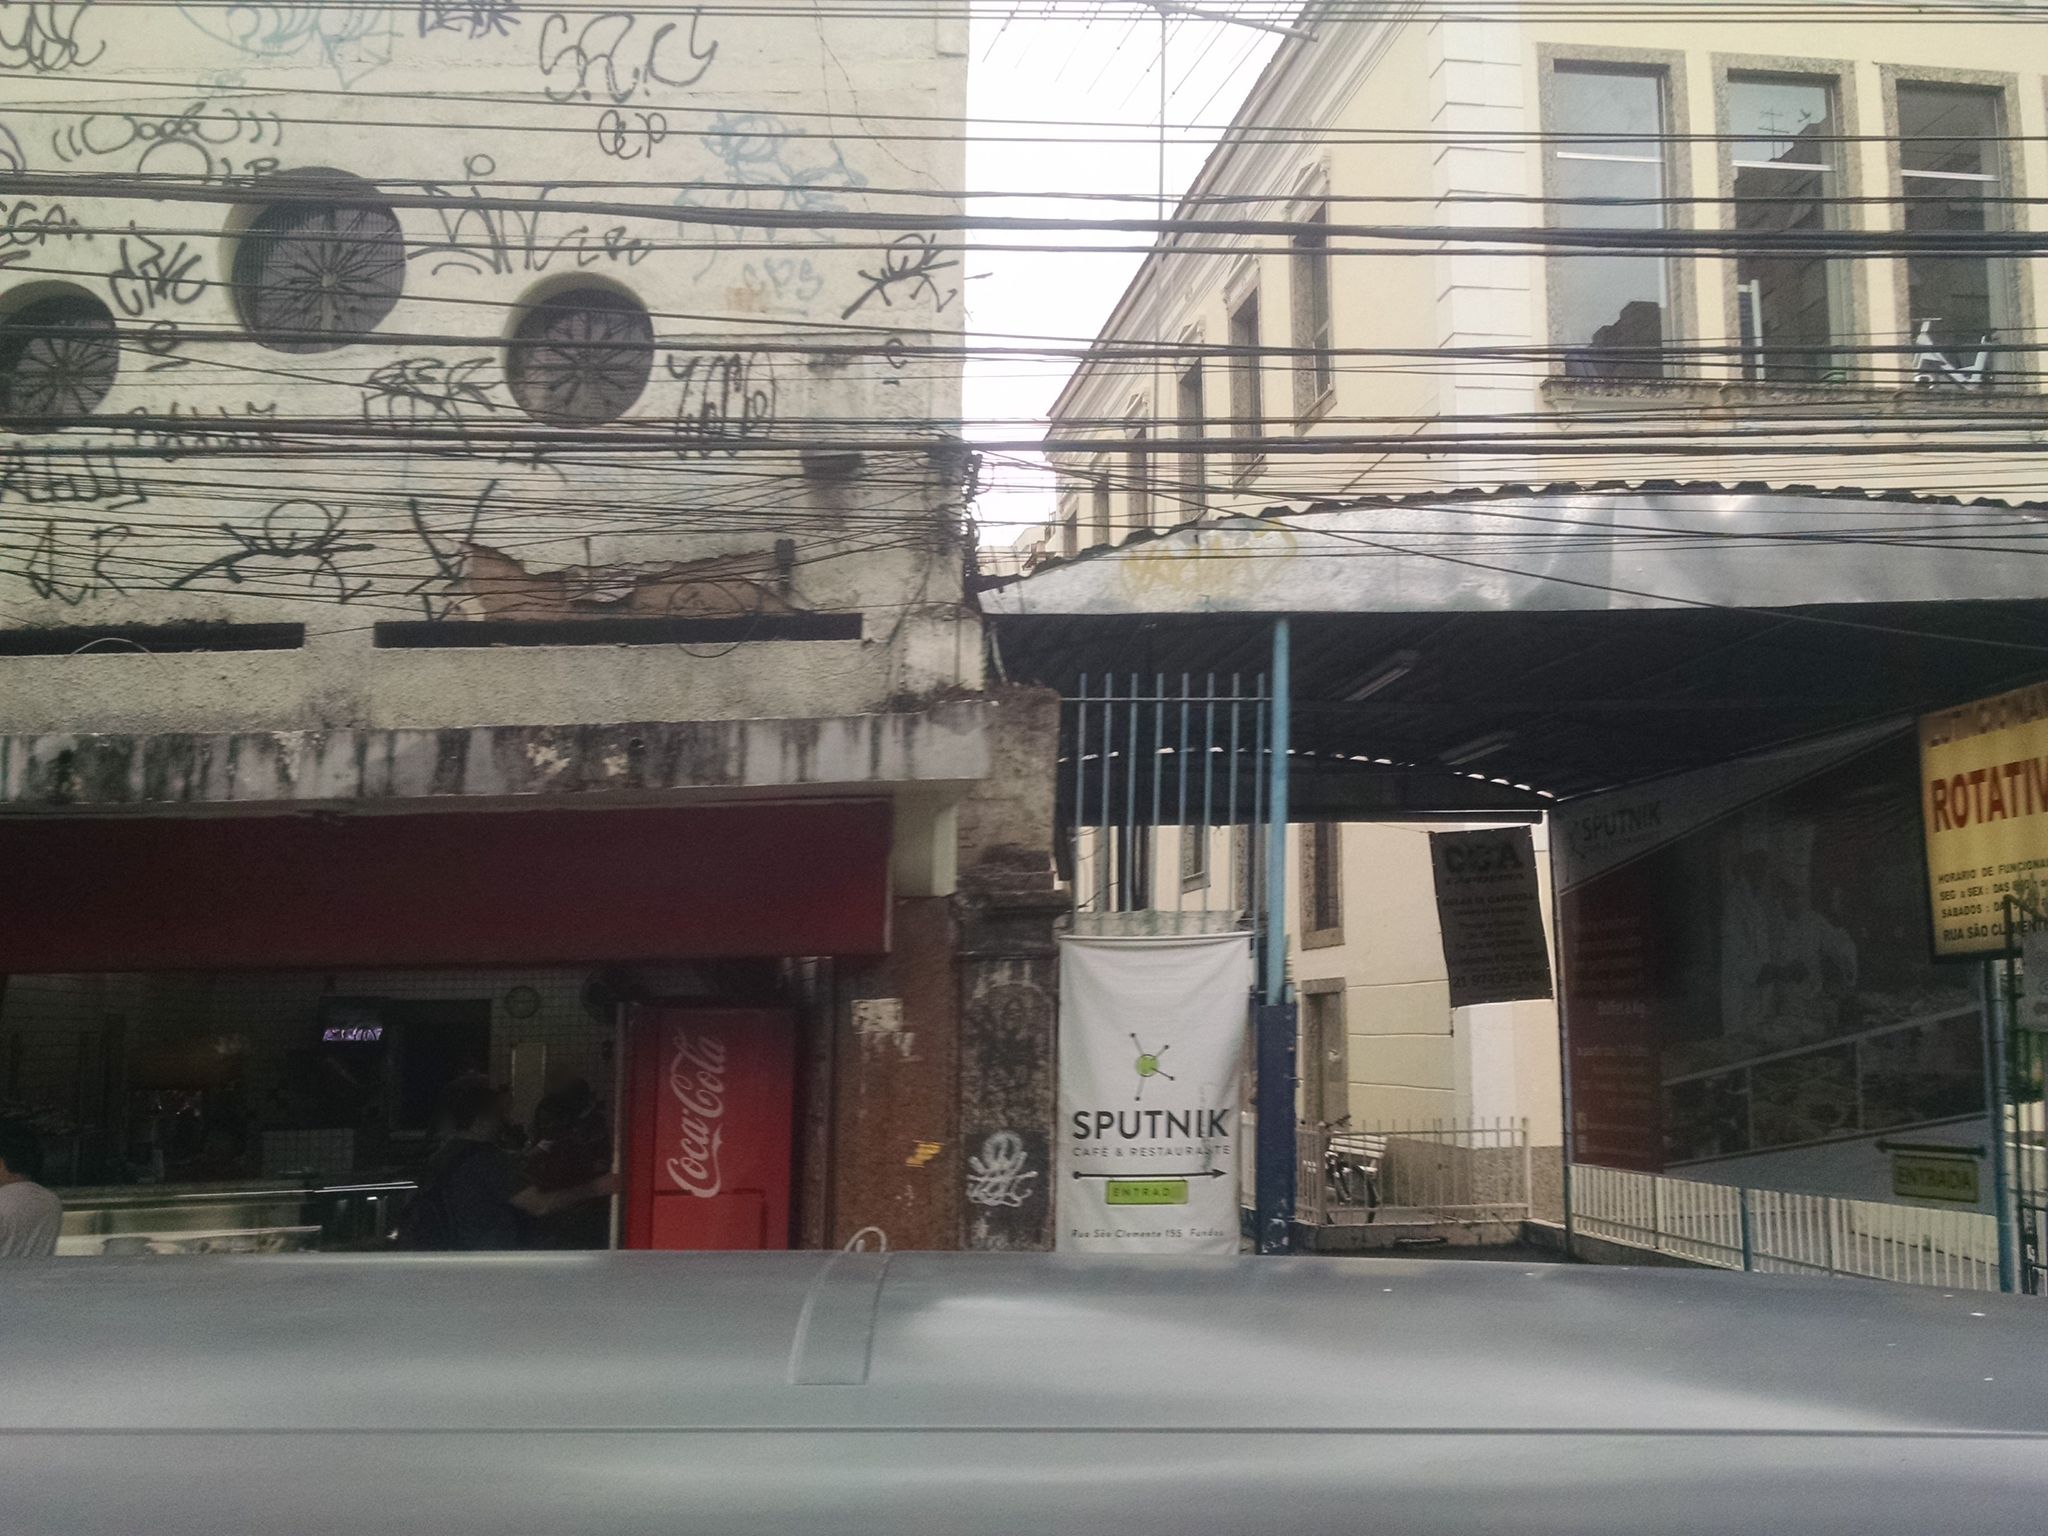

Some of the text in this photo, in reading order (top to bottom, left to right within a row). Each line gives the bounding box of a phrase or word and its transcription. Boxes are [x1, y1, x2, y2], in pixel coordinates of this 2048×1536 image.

[1582, 800, 1662, 842] SPUTNIK
[1981, 866, 1994, 878] DE
[1939, 888, 1957, 902] SEG
[1993, 882, 2010, 894] DAS
[1943, 925, 1965, 942] RUA
[1967, 922, 1988, 940] SÃO
[1072, 1108, 1230, 1140] SPUTNIK
[1129, 1145, 1231, 1158] RESTAURANTE
[1897, 1165, 1972, 1189] ENTRADA
[1071, 1229, 1089, 1238] Rua
